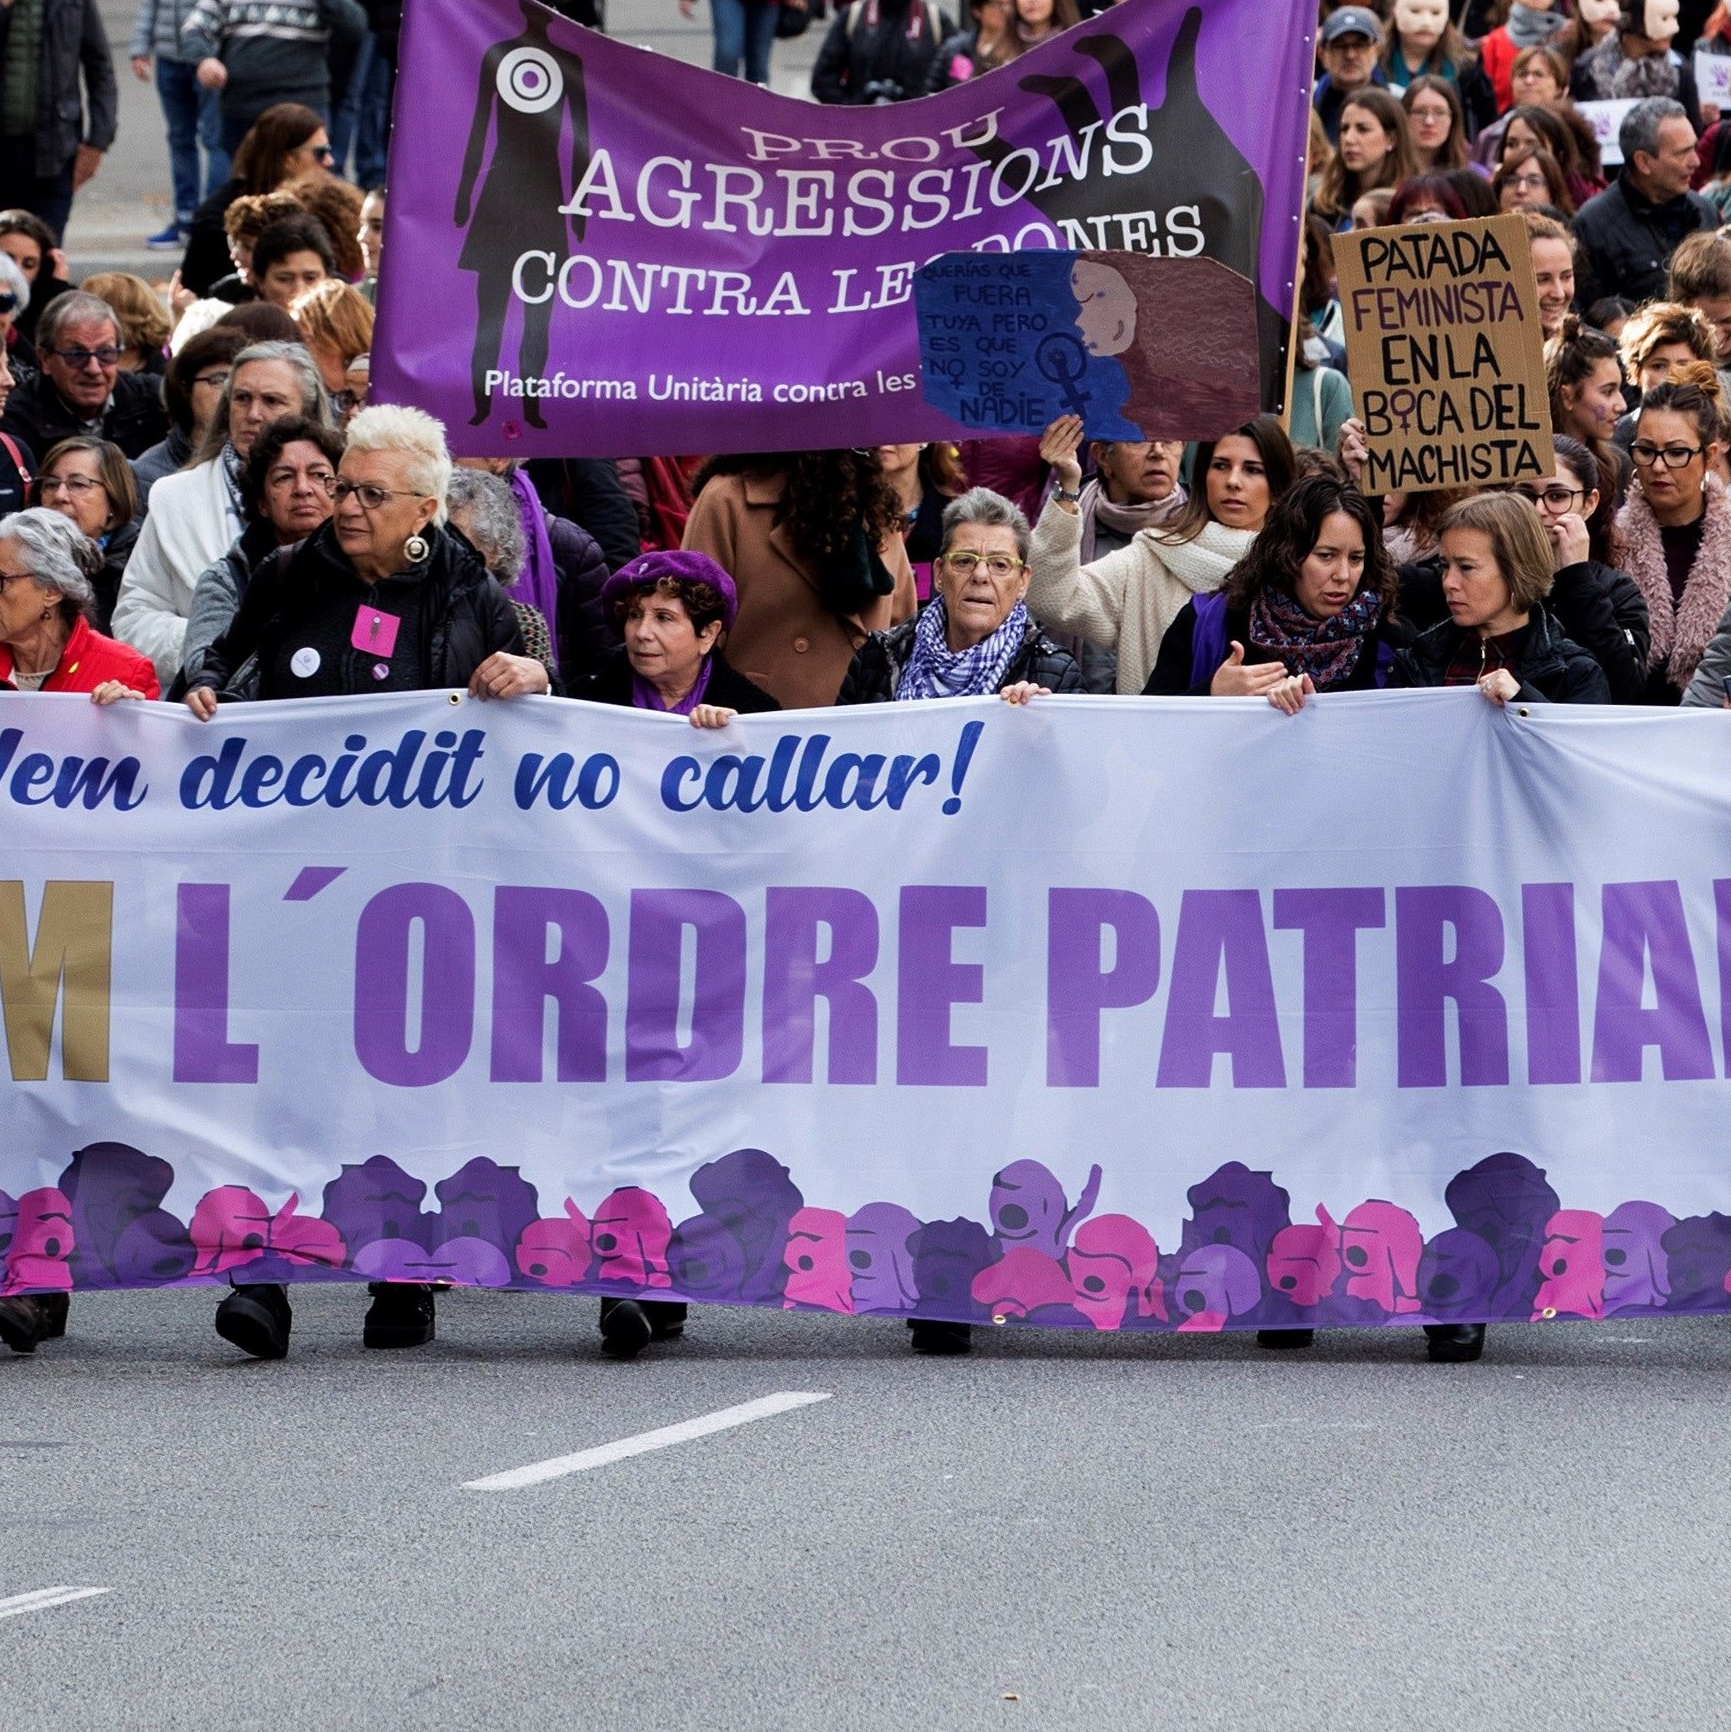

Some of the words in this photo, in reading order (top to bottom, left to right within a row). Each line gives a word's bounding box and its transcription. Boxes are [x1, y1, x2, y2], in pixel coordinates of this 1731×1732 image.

[741, 108, 1005, 163] PROU
[558, 104, 1154, 238] AGRESSIONS
[999, 264, 1032, 278] QUE
[1361, 229, 1511, 283] PATADA
[511, 250, 810, 316] CONTRA
[826, 253, 946, 315] LE
[954, 284, 1031, 306] FUERA
[1352, 280, 1524, 332] FEMINISTA
[926, 315, 981, 333] TUYA
[993, 314, 1047, 333] PERO
[929, 337, 961, 352] ES
[976, 336, 1017, 354] QUE
[485, 369, 637, 404] Plataforma
[648, 374, 763, 404] Unitària
[773, 377, 868, 403] contra
[876, 371, 915, 393] les
[979, 361, 1026, 378] SOY
[979, 381, 1006, 397] DE
[1469, 383, 1540, 431] DEL
[1368, 439, 1543, 490] MACHISTA
[178, 729, 485, 810] decidit
[514, 750, 621, 810] no
[660, 720, 985, 816] callar!
